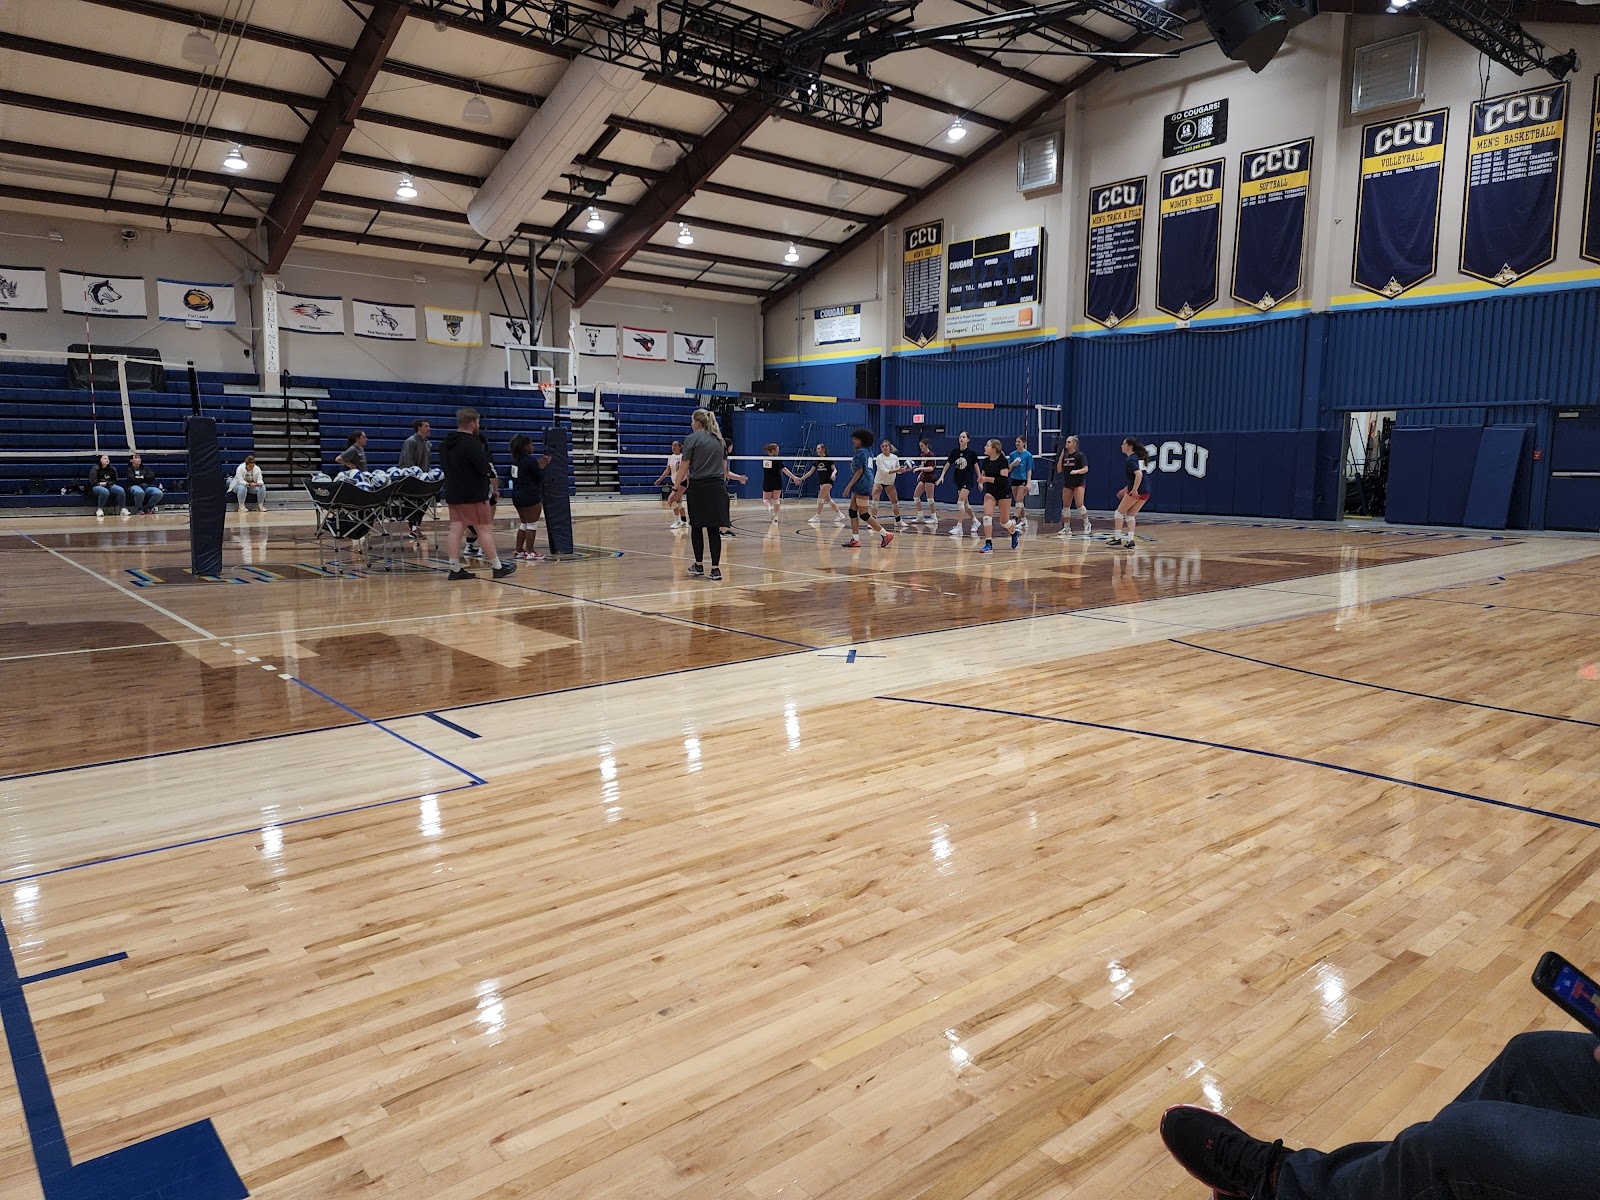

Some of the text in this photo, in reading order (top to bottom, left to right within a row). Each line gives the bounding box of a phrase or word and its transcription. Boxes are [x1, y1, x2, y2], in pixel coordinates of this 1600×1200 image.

[1171, 102, 1220, 121] GO COUGARS!
[1484, 95, 1552, 133] CCU
[1374, 120, 1434, 154] CCU
[1476, 125, 1556, 150] MEN'S BASKETBALL
[1509, 144, 1532, 153] CHAMPIONS
[1529, 151, 1553, 160] CHAMPIONS
[1250, 148, 1300, 180] CCU
[1382, 152, 1424, 167] VOLLEYBALL
[1528, 162, 1552, 171] CHAMPIONS
[1528, 168, 1552, 177] CHAMPIONS
[1170, 167, 1214, 197] CCU
[1260, 178, 1288, 191] SOFTBALL
[1098, 185, 1137, 212] CCU
[1170, 194, 1214, 209] WOMEN'S SOCCER
[1092, 216, 1105, 224] MEN'S
[1107, 212, 1121, 222] TRACK
[1129, 208, 1141, 218] FIELD
[910, 227, 937, 250] CCU
[1014, 248, 1033, 258] GUEST
[949, 258, 974, 270] COUGARS
[978, 281, 992, 289] PLAYER
[820, 307, 844, 318] COUGAR
[972, 324, 985, 332] CCU
